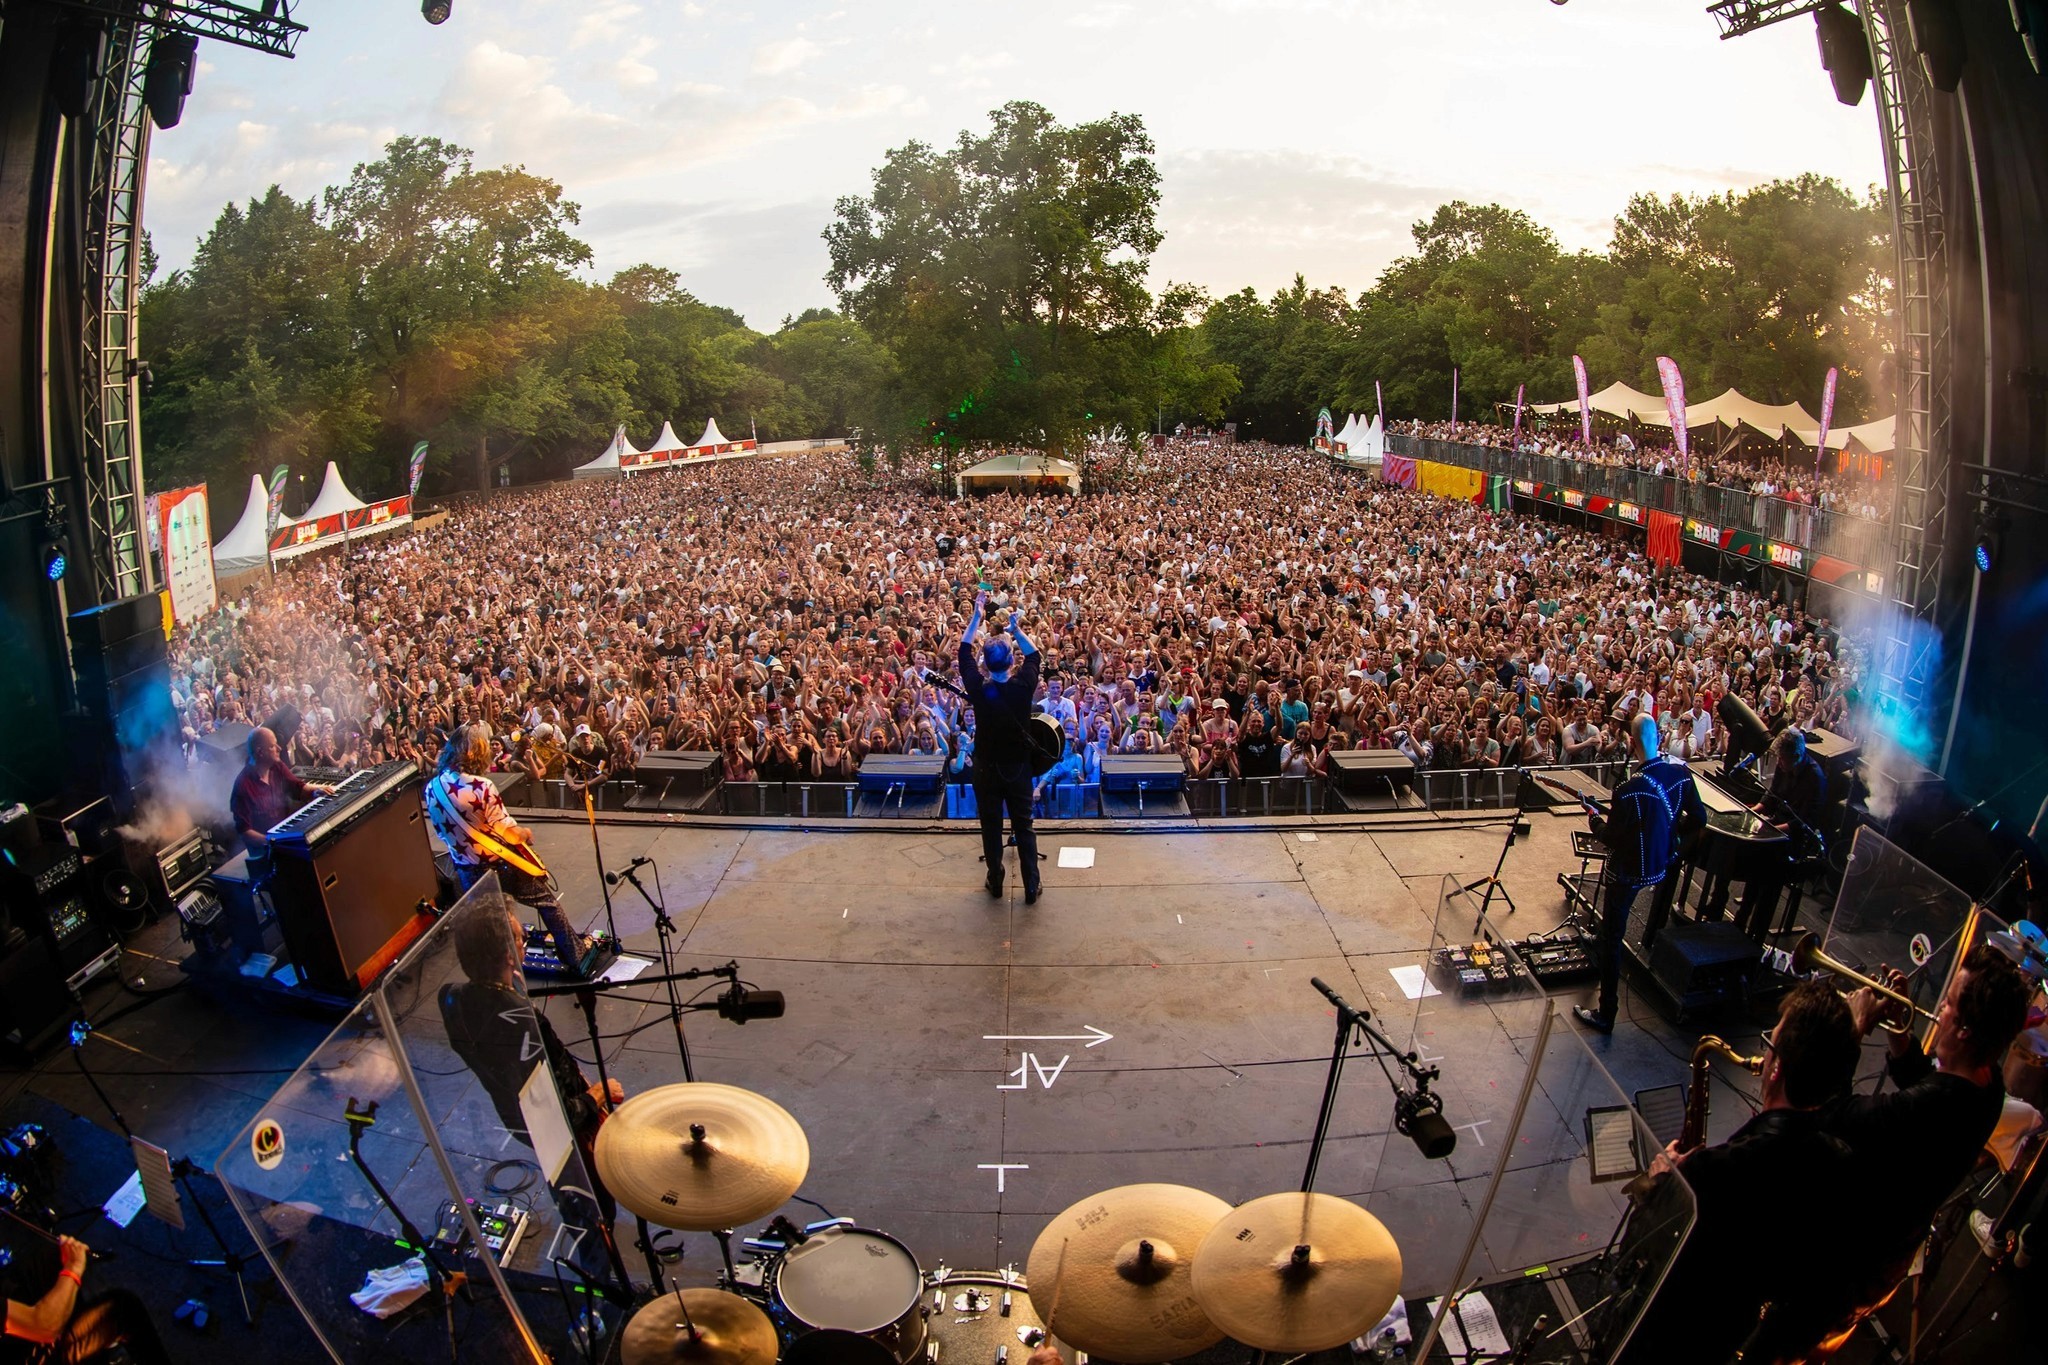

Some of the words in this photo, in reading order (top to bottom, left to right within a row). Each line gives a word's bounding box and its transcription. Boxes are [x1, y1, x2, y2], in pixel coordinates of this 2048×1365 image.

[1519, 480, 1534, 495] BAR
[1564, 491, 1583, 507] BAR
[372, 506, 389, 519] BAR
[1618, 503, 1640, 521] BAR
[297, 524, 318, 538] BAR
[1694, 522, 1719, 545] BAR
[1771, 544, 1802, 569] BAR
